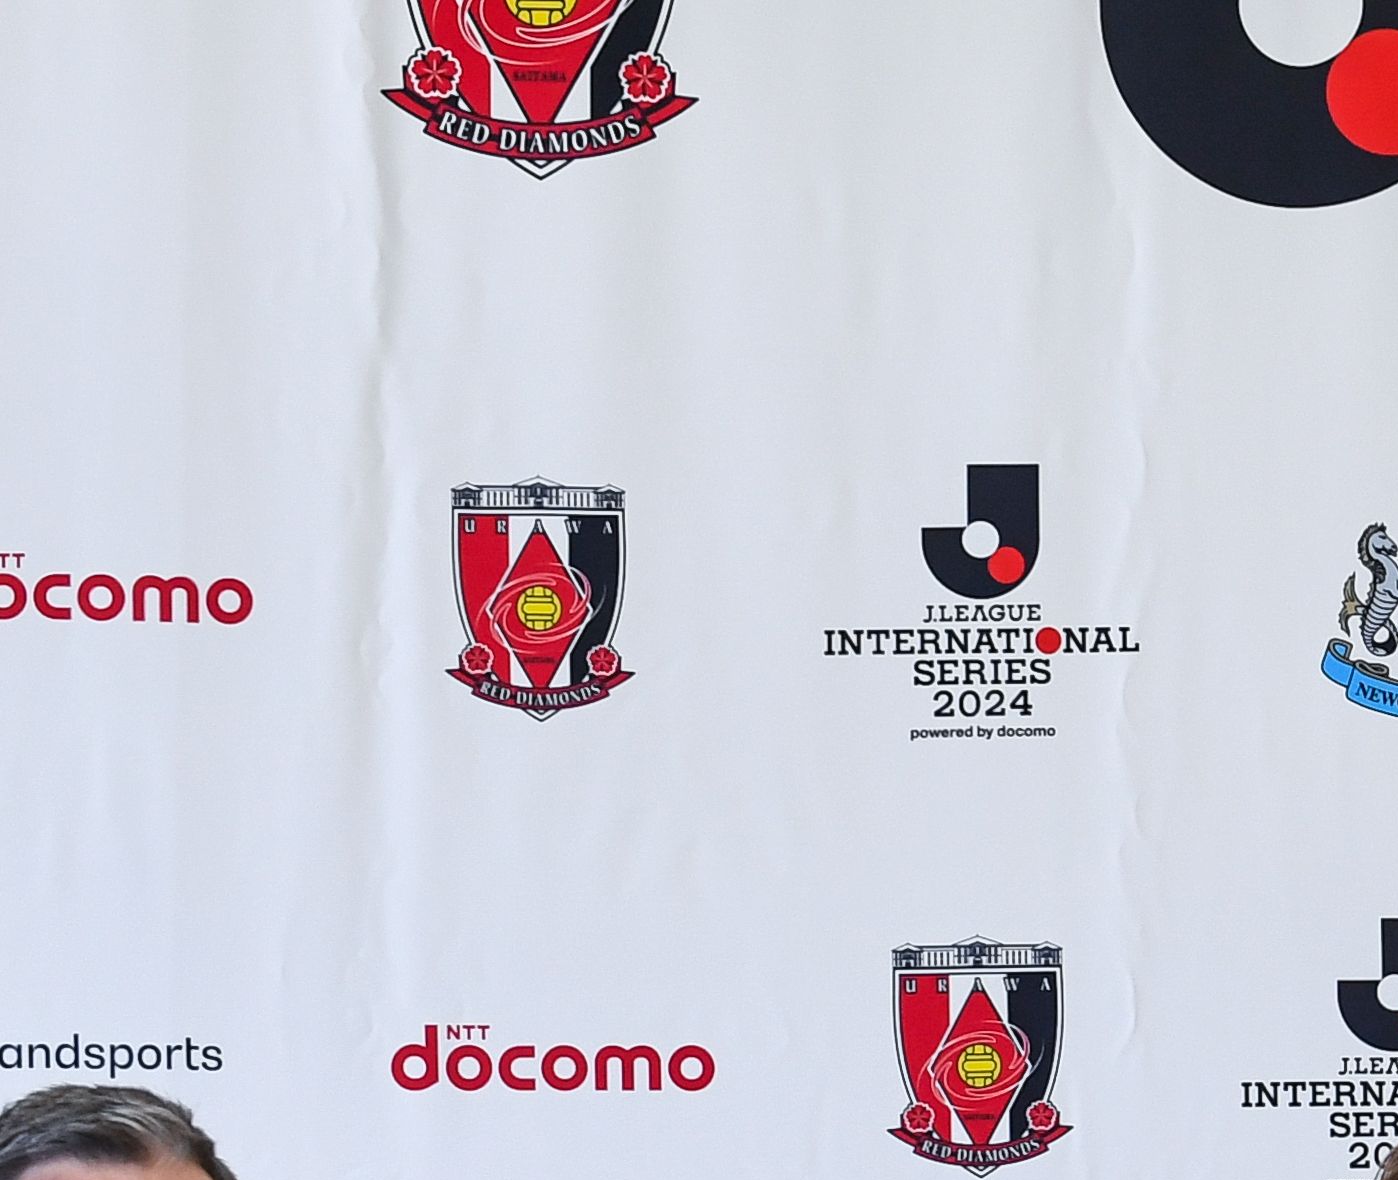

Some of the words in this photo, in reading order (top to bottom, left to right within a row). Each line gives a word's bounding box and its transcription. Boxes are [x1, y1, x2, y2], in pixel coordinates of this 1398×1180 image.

[438, 111, 491, 145] RED
[499, 115, 642, 154] DIAMONDS
[0, 553, 25, 568] TT
[0, 573, 254, 625] ocomo
[923, 603, 1042, 623] J.LEAGUE
[824, 626, 1140, 656] INTERNATIONAL
[913, 658, 1051, 686] SERIES
[480, 680, 511, 700] RED
[516, 682, 602, 707] DIAMONDS
[933, 689, 1033, 718] 2024
[910, 726, 974, 741] powered
[977, 725, 994, 740] by
[997, 725, 1056, 738] docomo
[446, 1025, 490, 1041] NTT
[0, 1033, 223, 1079] andsports
[390, 1024, 716, 1092] docomo
[921, 1138, 952, 1159] RED
[956, 1137, 1041, 1163] DIAMONDS
